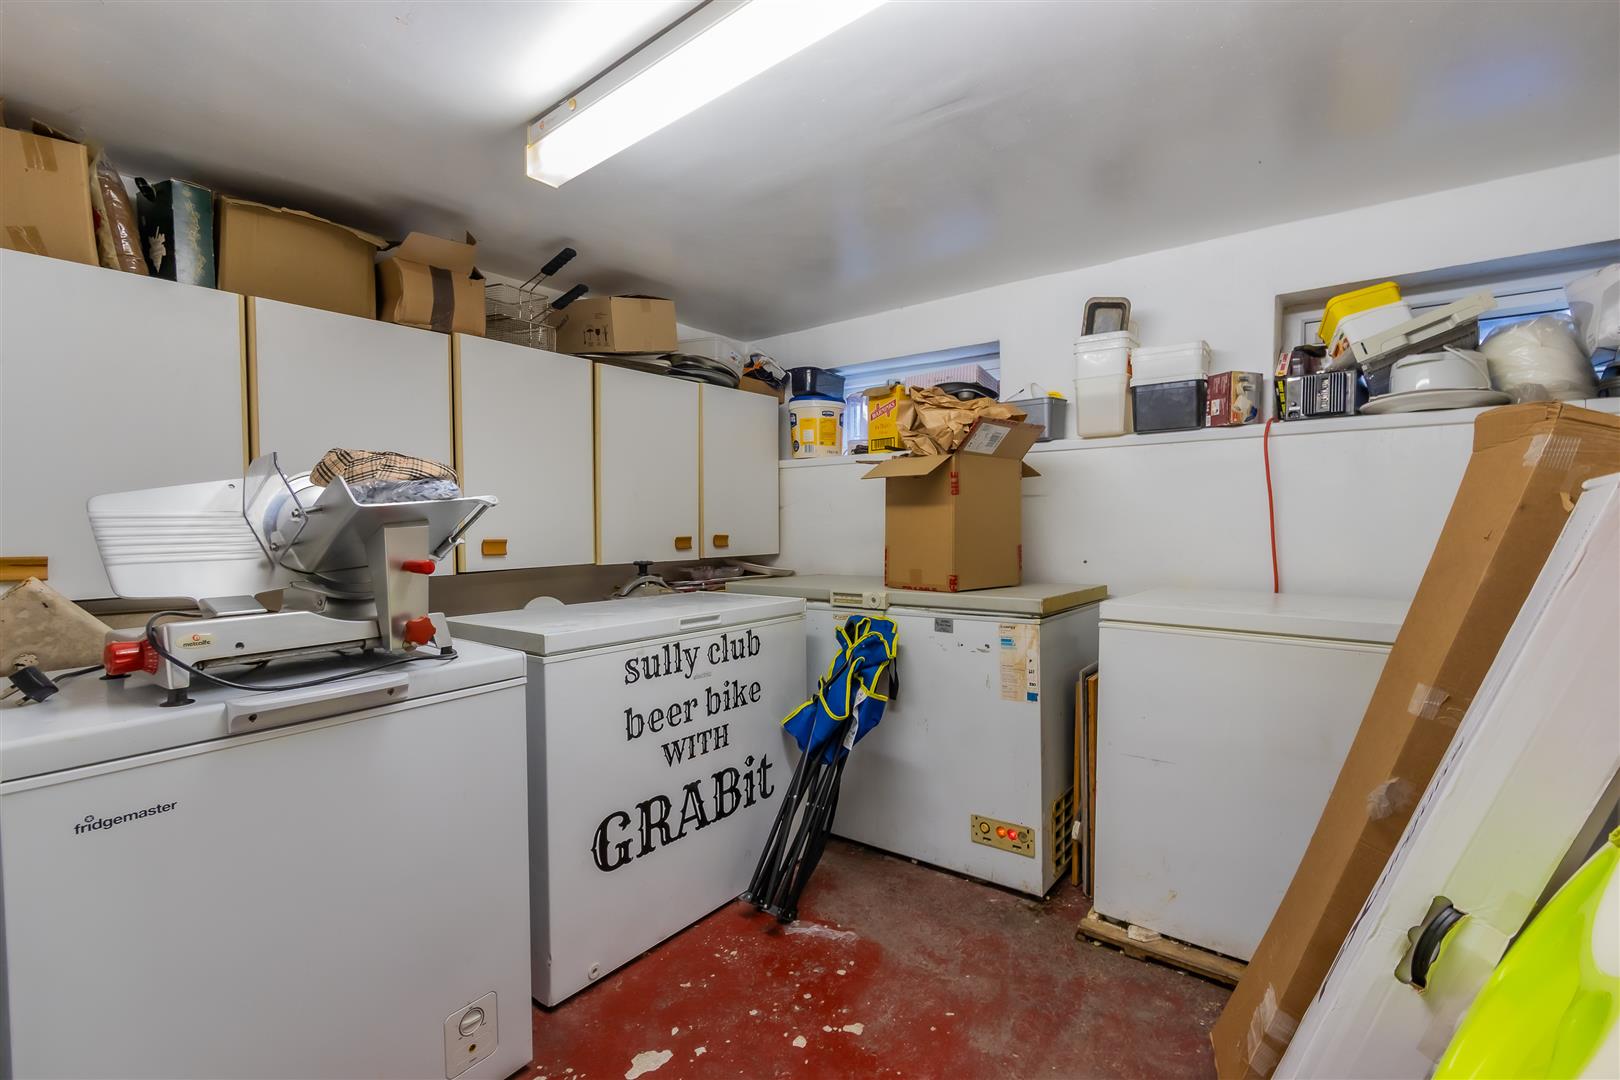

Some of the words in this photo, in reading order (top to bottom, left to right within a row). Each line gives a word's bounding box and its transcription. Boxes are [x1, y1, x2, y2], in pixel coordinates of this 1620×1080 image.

[624, 641, 700, 685] sully
[707, 629, 761, 665] club
[623, 697, 698, 742] beer
[704, 679, 762, 717] bike
[660, 723, 730, 768] WITH
[73, 801, 178, 835] fridgemaster
[590, 753, 775, 873] GRABit
